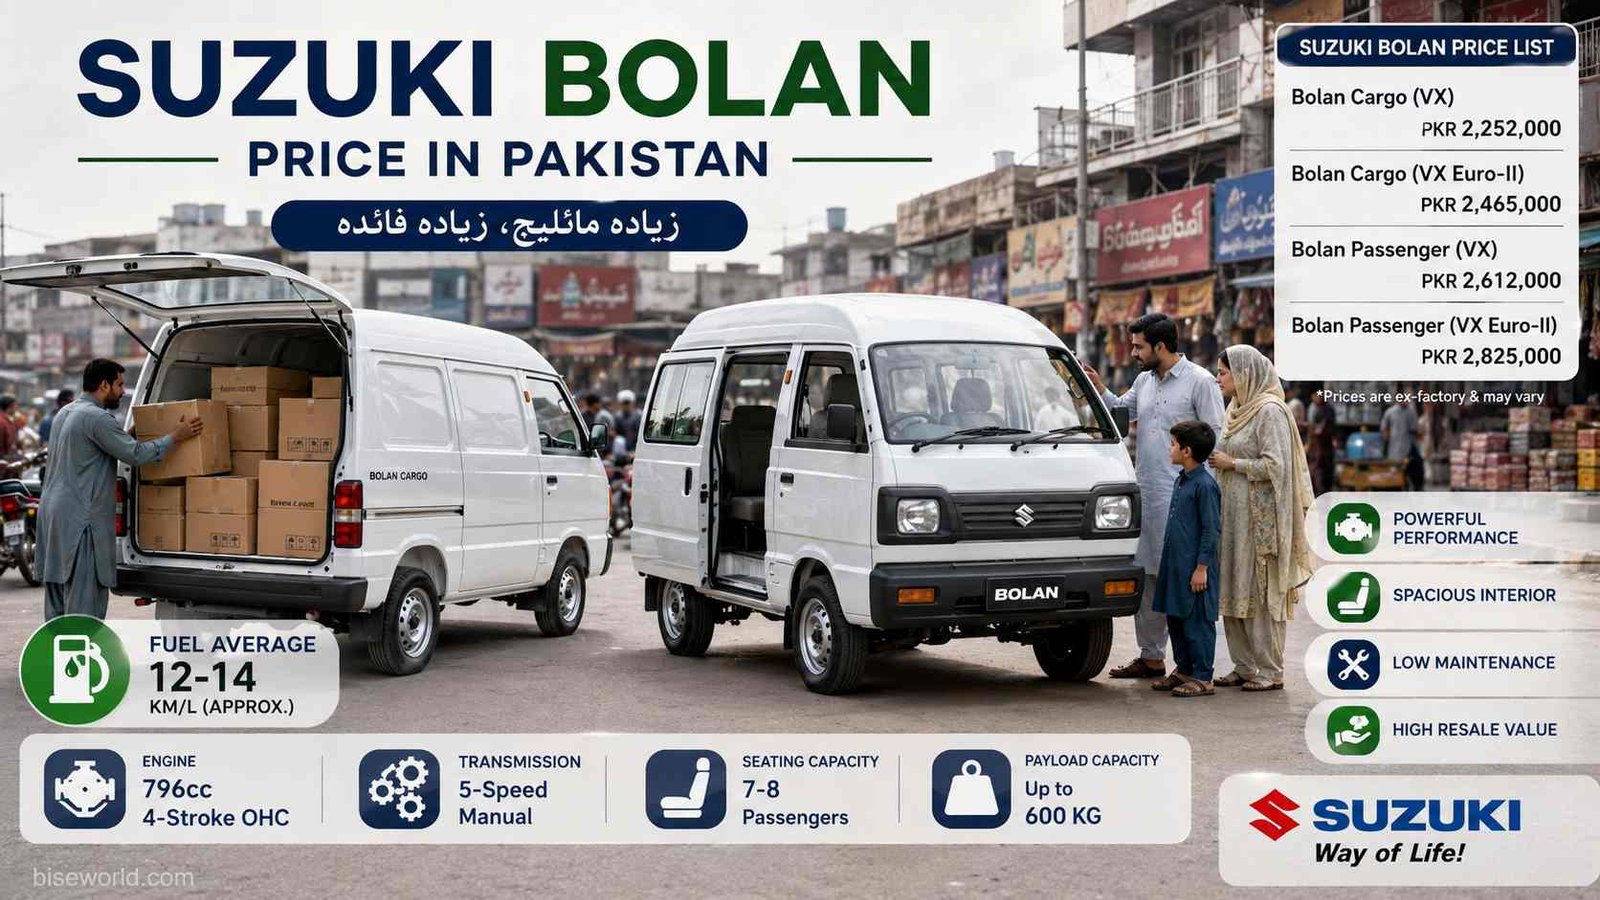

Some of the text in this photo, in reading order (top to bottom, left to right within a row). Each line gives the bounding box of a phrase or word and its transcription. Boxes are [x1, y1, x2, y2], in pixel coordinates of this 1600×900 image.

[370, 472, 427, 480] BOLAN CARGO
[995, 587, 1058, 601] BOLAN
